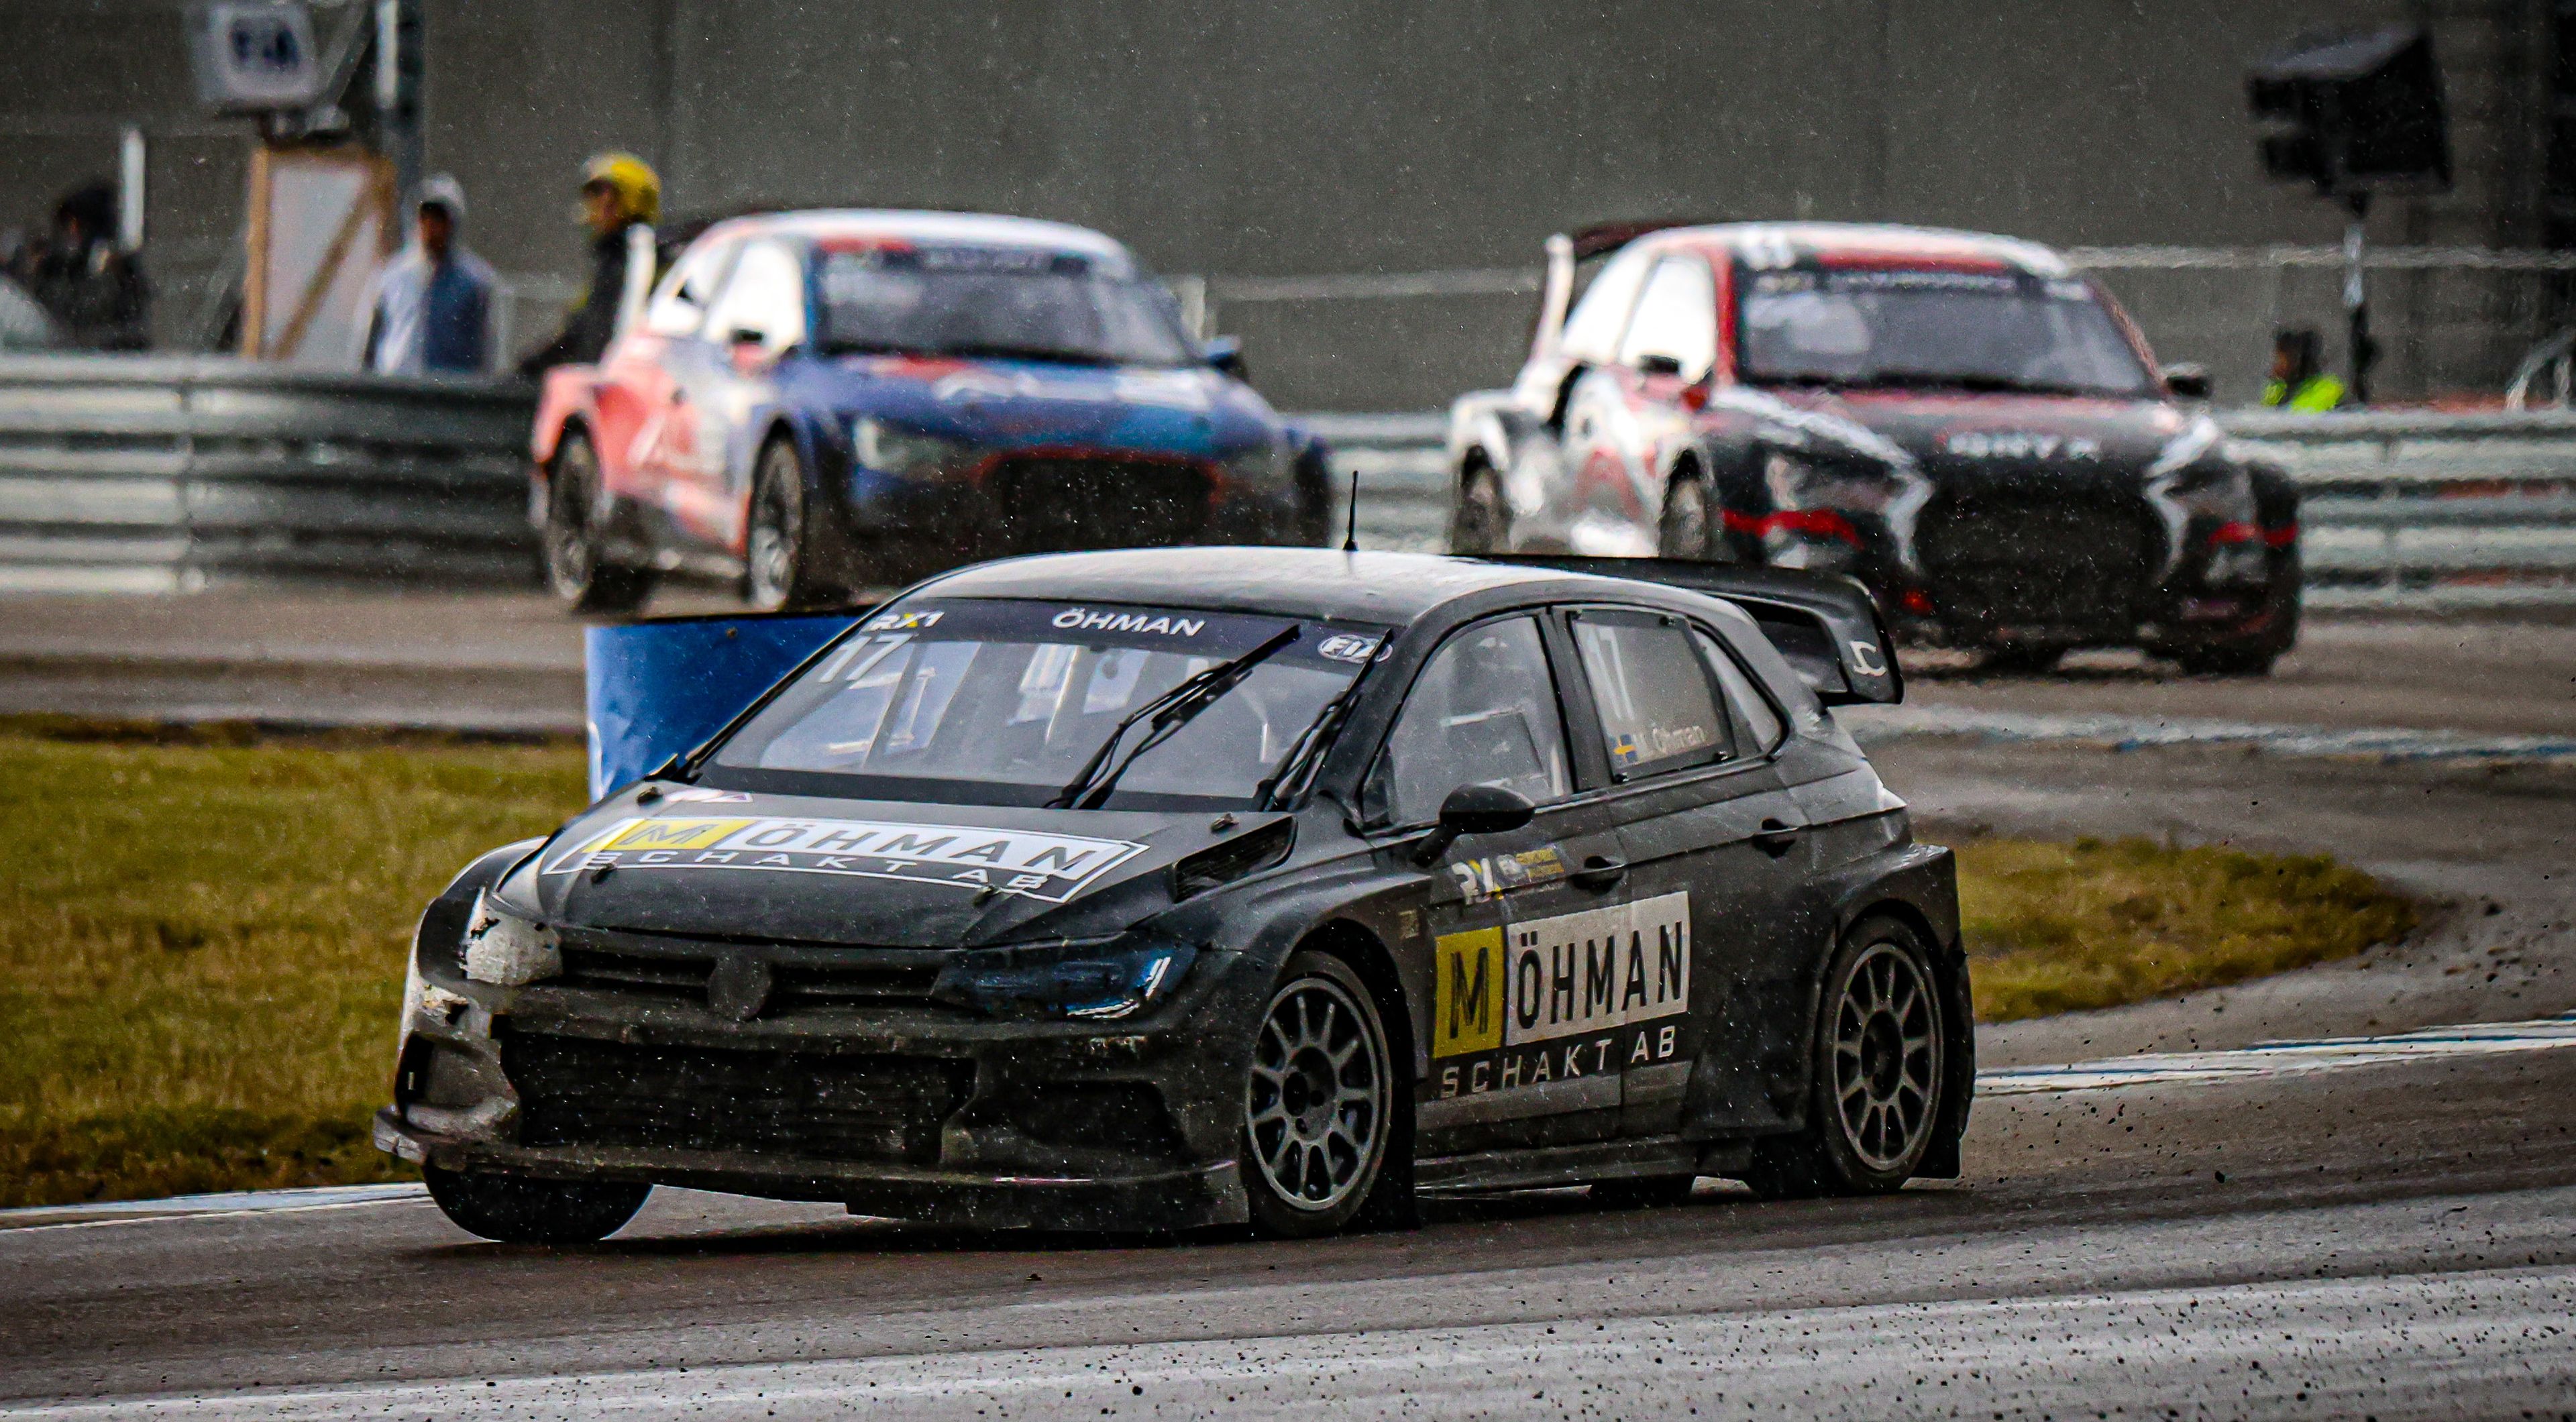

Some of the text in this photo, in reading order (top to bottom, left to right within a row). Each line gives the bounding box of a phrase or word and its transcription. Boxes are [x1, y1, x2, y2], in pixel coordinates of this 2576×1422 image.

[1052, 608, 1205, 637] ÖHMAN
[818, 633, 915, 683] 17
[585, 851, 1049, 889] SCHAKT AB
[617, 823, 1099, 871] M ÖHMAN
[1449, 921, 1683, 1040] M ÖHMAN
[1440, 1025, 1676, 1099] SCHAKT AB
